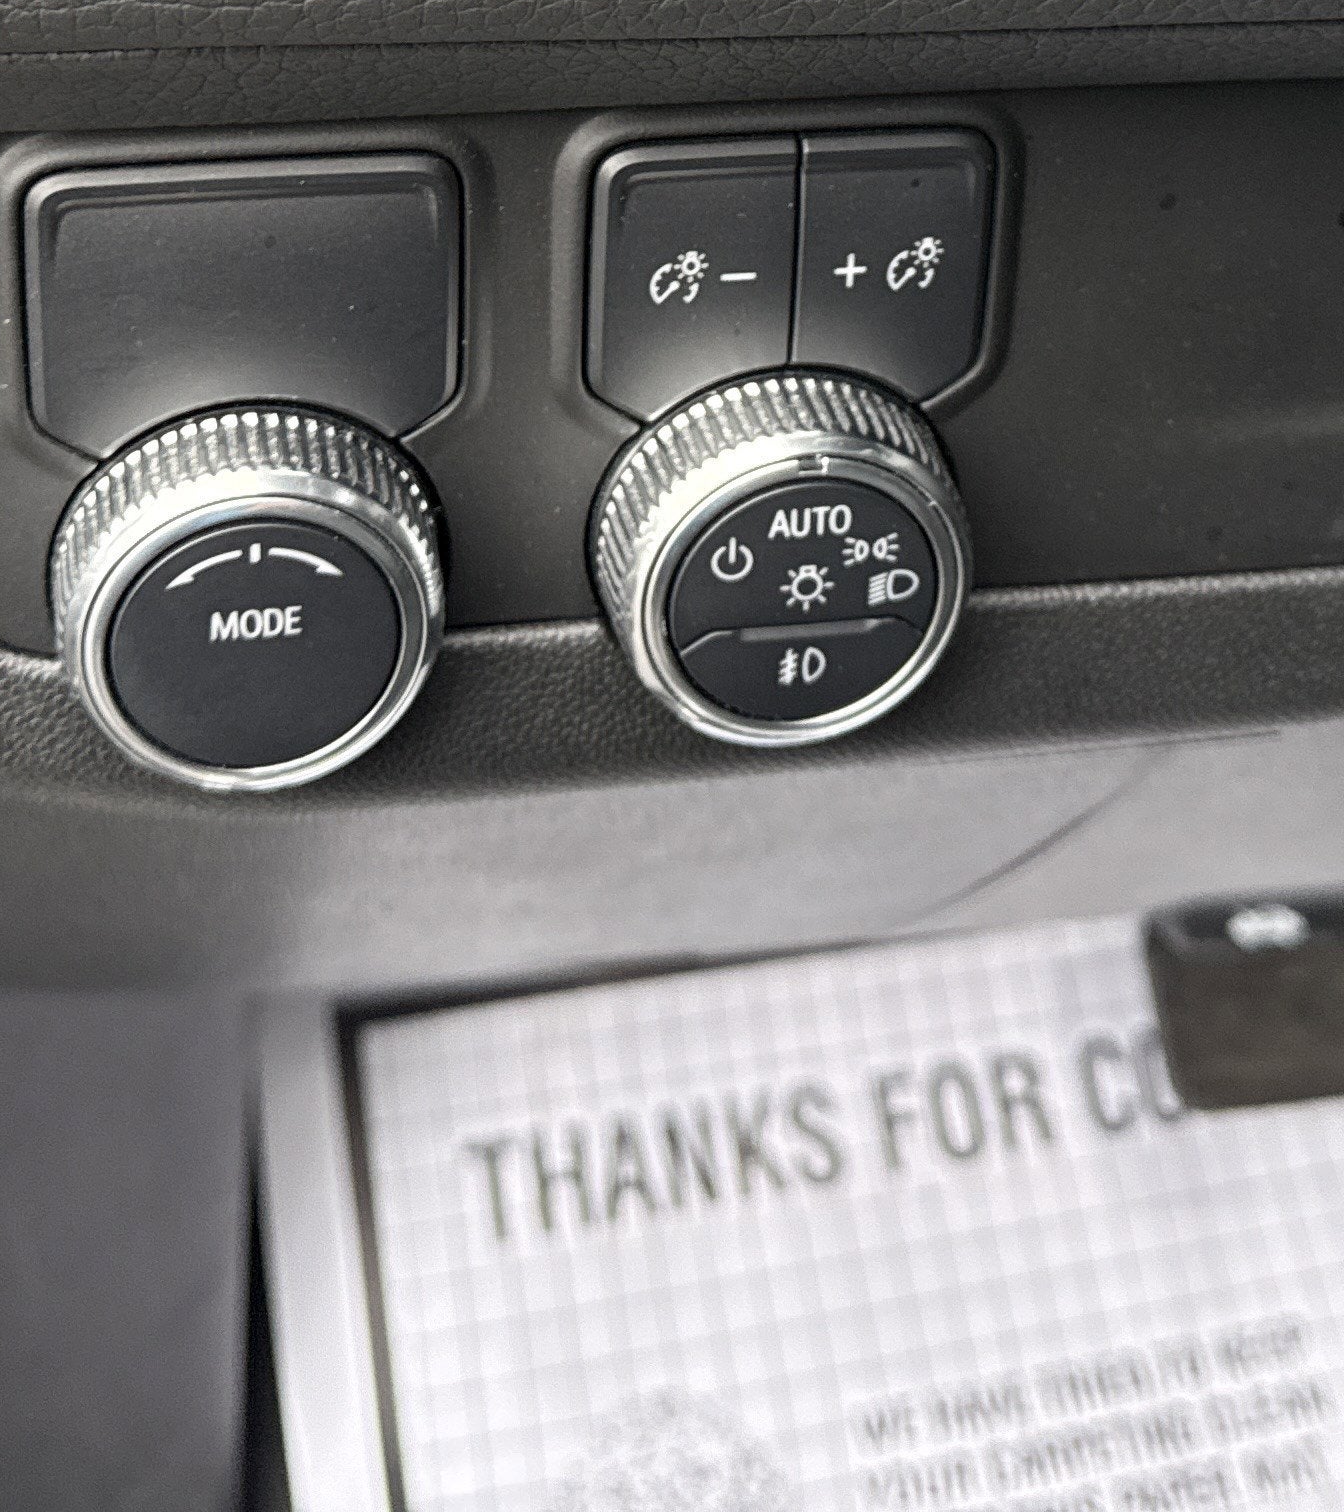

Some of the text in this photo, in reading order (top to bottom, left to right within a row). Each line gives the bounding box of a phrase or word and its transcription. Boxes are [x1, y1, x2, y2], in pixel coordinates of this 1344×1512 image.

[768, 504, 853, 540] AUTO
[209, 605, 303, 643] MODE
[464, 1076, 844, 1241] THANKS
[870, 1048, 1054, 1171] FOR
